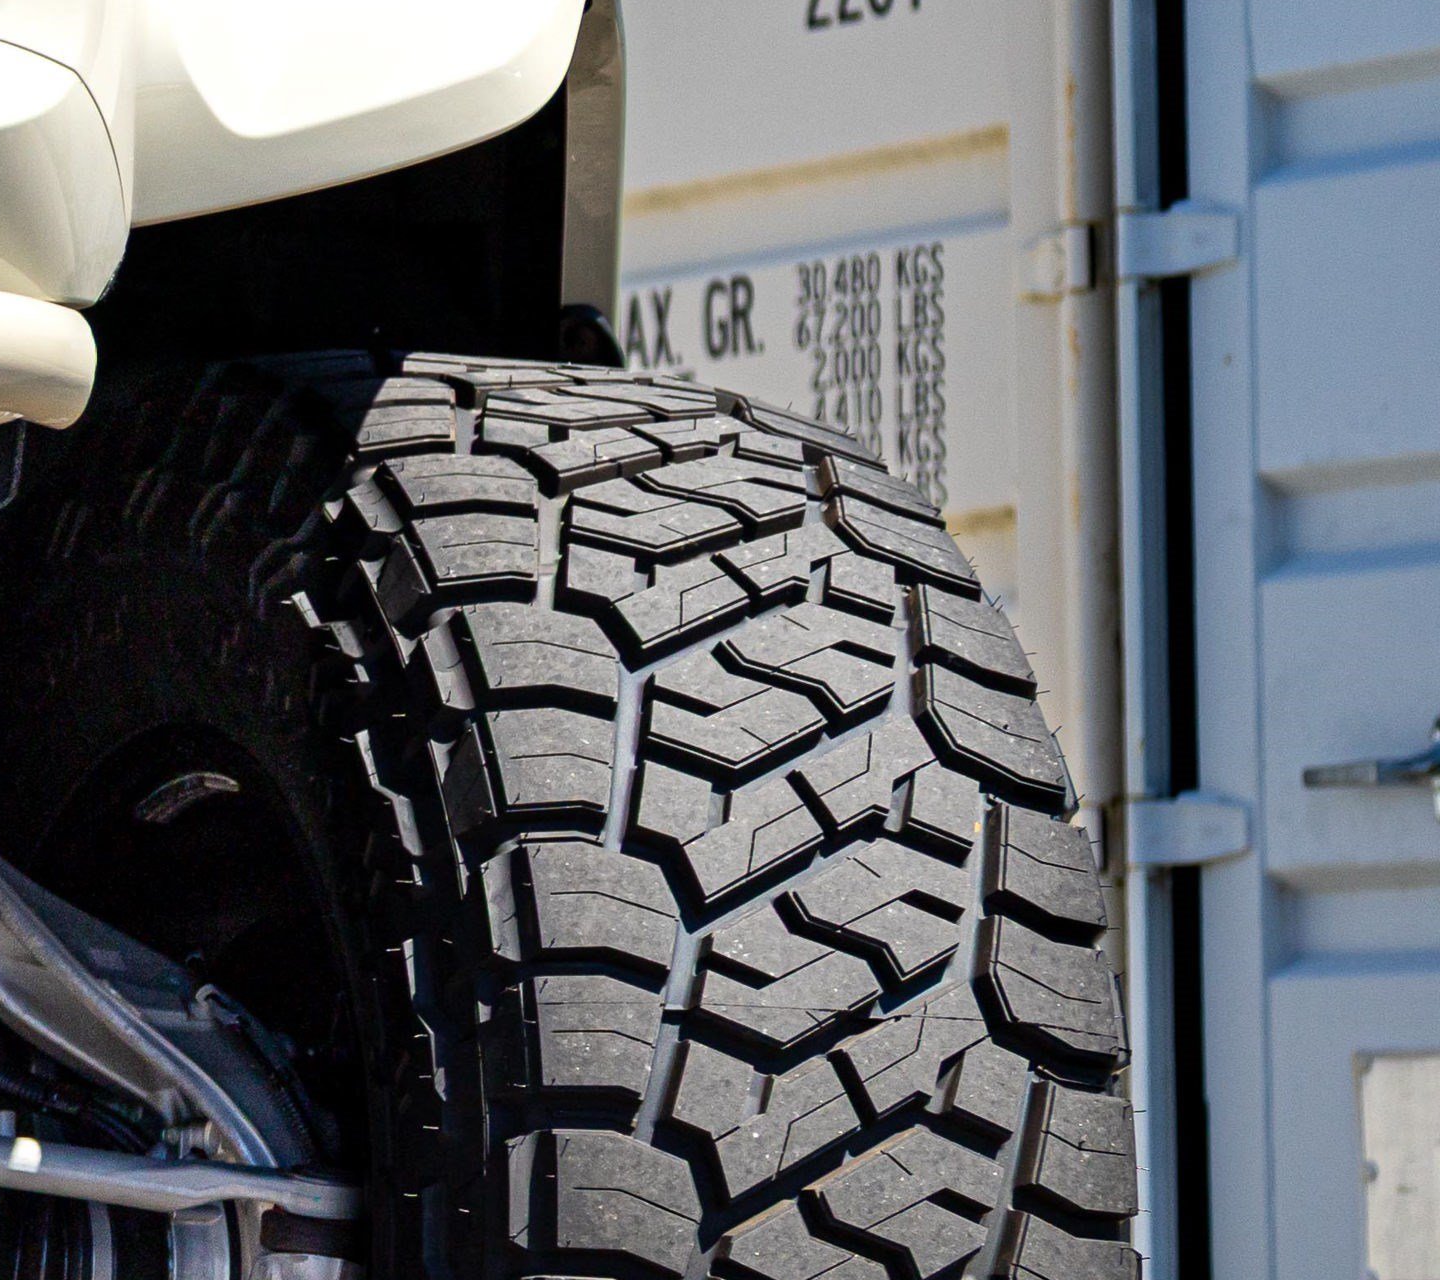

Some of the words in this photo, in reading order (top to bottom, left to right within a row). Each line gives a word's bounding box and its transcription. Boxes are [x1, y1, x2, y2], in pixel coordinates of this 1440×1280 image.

[896, 242, 945, 287] KGS
[624, 284, 682, 369] AX.
[703, 274, 765, 359] GR.
